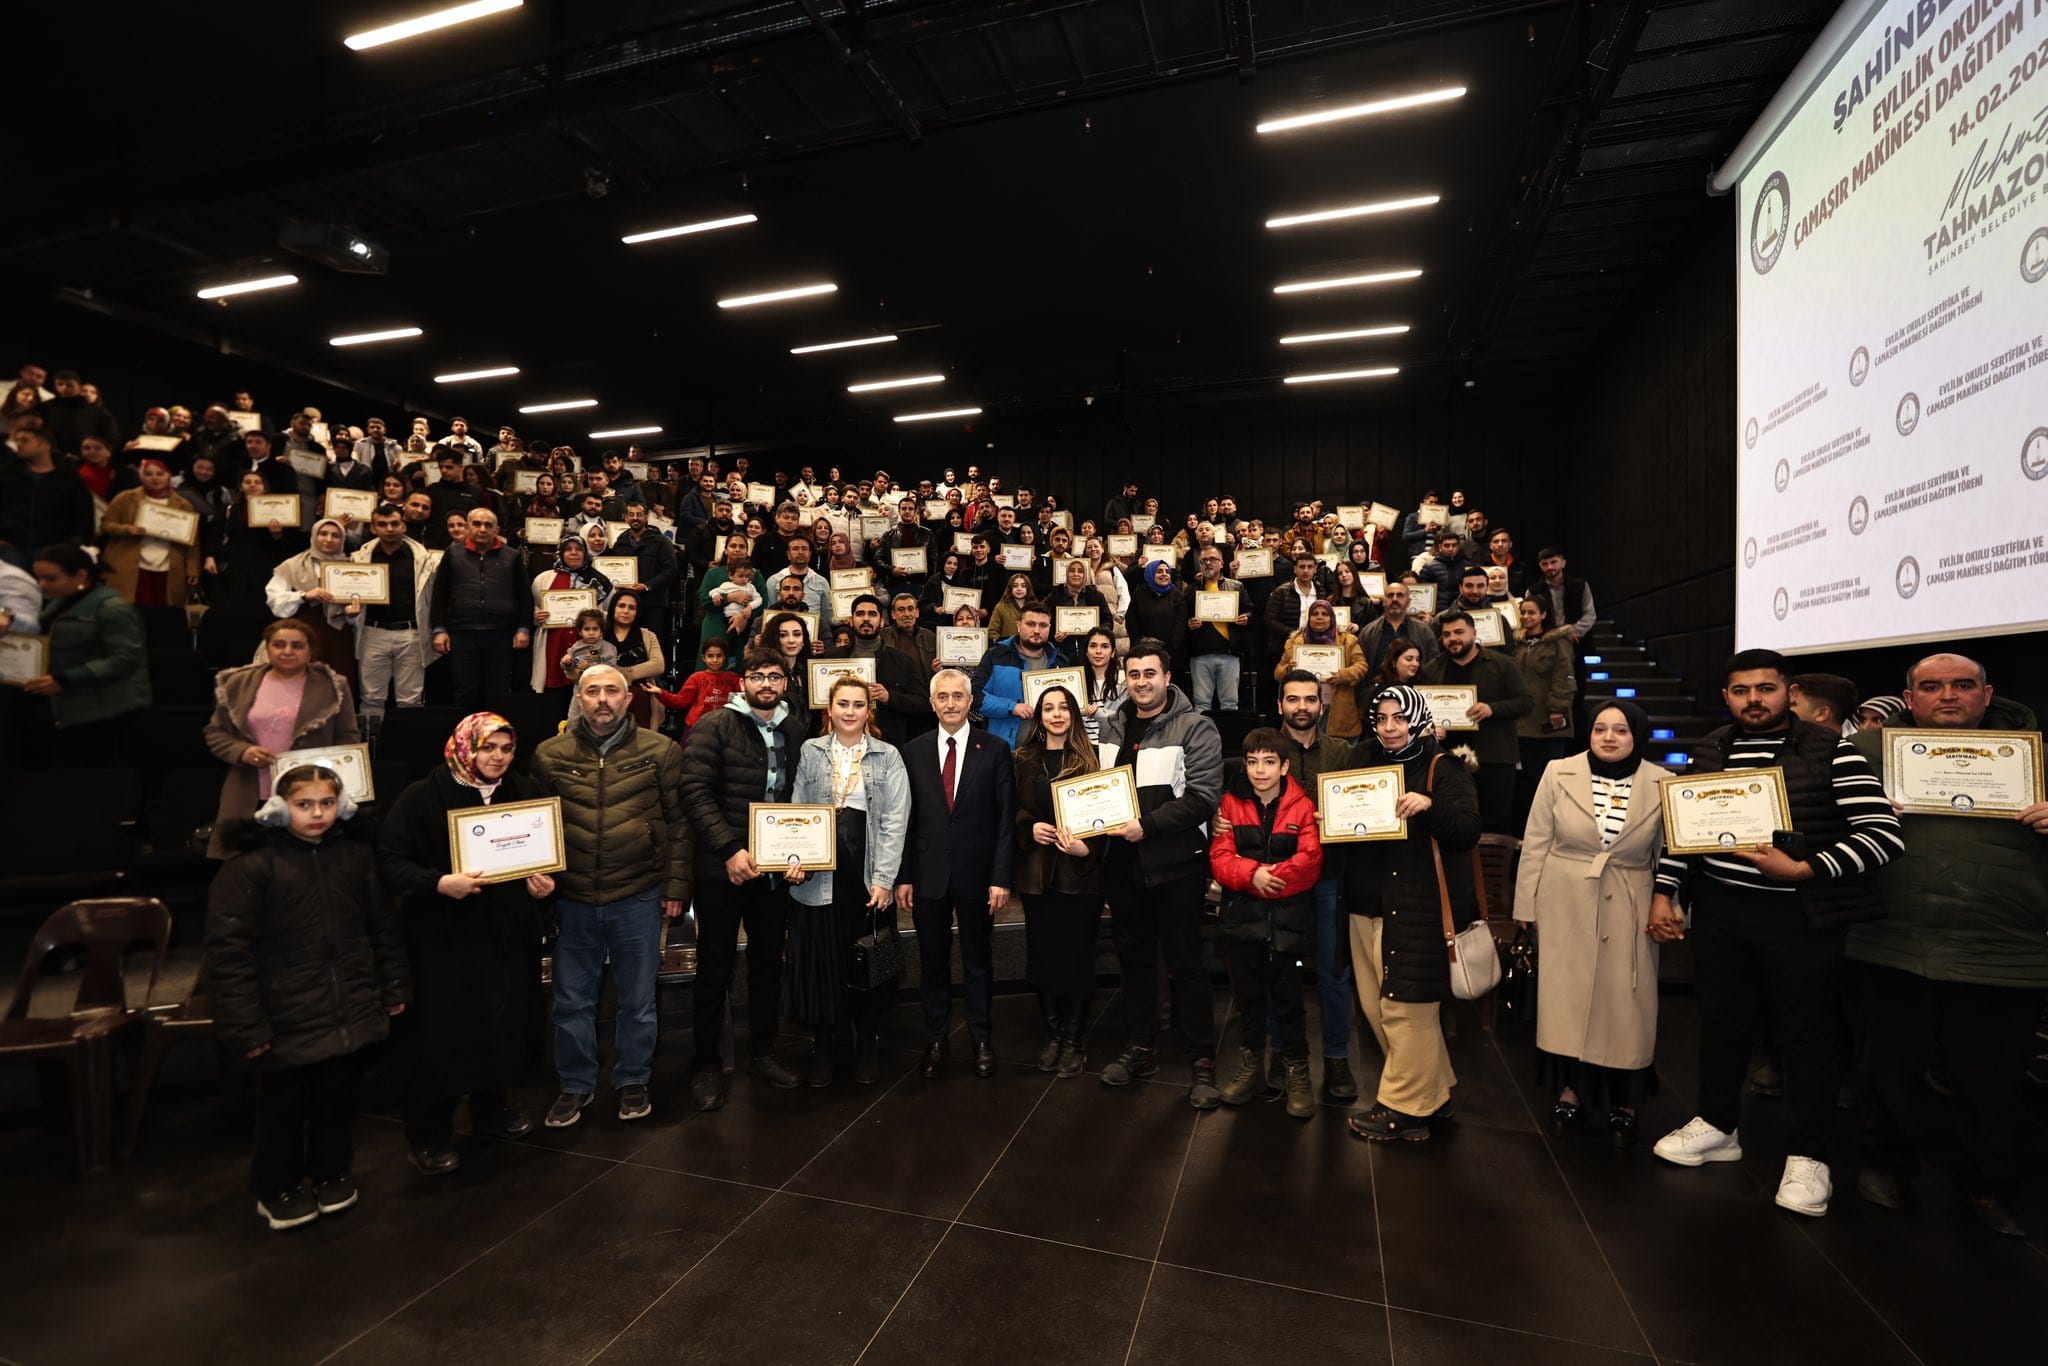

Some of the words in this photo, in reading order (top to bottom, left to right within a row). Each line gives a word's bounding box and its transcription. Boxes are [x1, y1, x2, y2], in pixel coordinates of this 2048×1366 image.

[1873, 46, 1934, 134] EVLİLİK
[1794, 176, 1849, 250] ÇAMAŞIR
[1852, 86, 1930, 193] MAKİNESİ
[1935, 0, 2023, 113] DAĞITIM
[1923, 149, 2048, 260] TAHMAZO
[1928, 235, 1976, 276] ŞAHİNBEY
[1981, 191, 2036, 238] BELEDİYE
[1885, 328, 1905, 348] EVLİLİK
[1906, 315, 1926, 333] OKULU
[1927, 292, 1959, 321] SERTİFİKA
[1960, 286, 1970, 299] VE
[1899, 325, 1928, 352] MAKİNESİ
[1929, 310, 1956, 333] DAĞITIM
[1957, 290, 1983, 316] TÖRENİ
[1939, 375, 1964, 396] EVLİLİK
[1965, 362, 1989, 383] OKULU
[1990, 342, 2030, 371] SERTİFİKA
[2031, 335, 2042, 350] VE
[1956, 375, 1991, 402] MAKİNESİ
[1993, 359, 2026, 385] DAĞITIM
[1884, 488, 1905, 504] EVLİLİK
[1906, 481, 1926, 497] OKULU
[1927, 469, 1959, 490] SERTİFİKA
[1960, 465, 1970, 477] VE
[1898, 491, 1928, 512] MAKİNESİ
[1929, 485, 1956, 502] DAĞITIM
[1958, 473, 1983, 493] TÖRENİ
[1939, 552, 1964, 569] EVLİLİK
[1965, 548, 1989, 563] OKULU
[1991, 538, 2031, 558] SERTİFİKA
[2032, 536, 2044, 549] VE
[1956, 561, 1992, 580] MAKİNESİ
[1993, 555, 2027, 573] DAĞITIM
